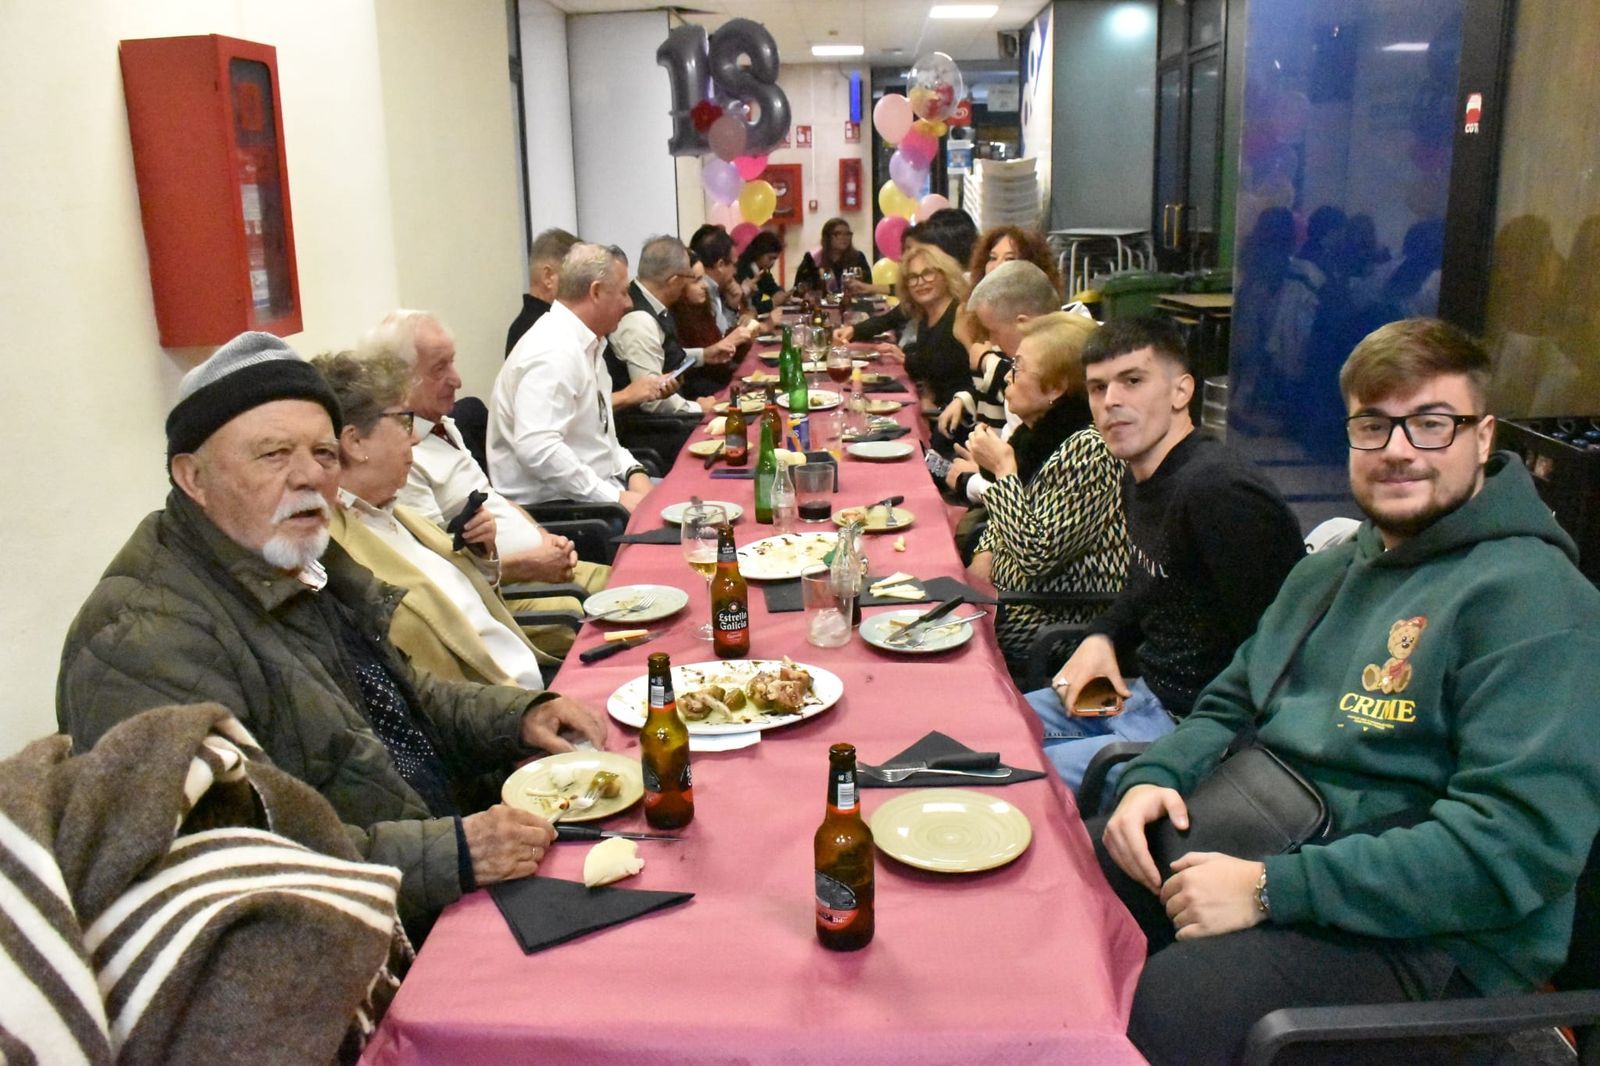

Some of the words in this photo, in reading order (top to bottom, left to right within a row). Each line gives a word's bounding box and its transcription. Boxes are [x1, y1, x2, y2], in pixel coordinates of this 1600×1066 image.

[656, 18, 791, 158] 18
[719, 611, 747, 622] Estrella
[720, 620, 747, 631] Galicia
[1339, 693, 1416, 722] CRIME
